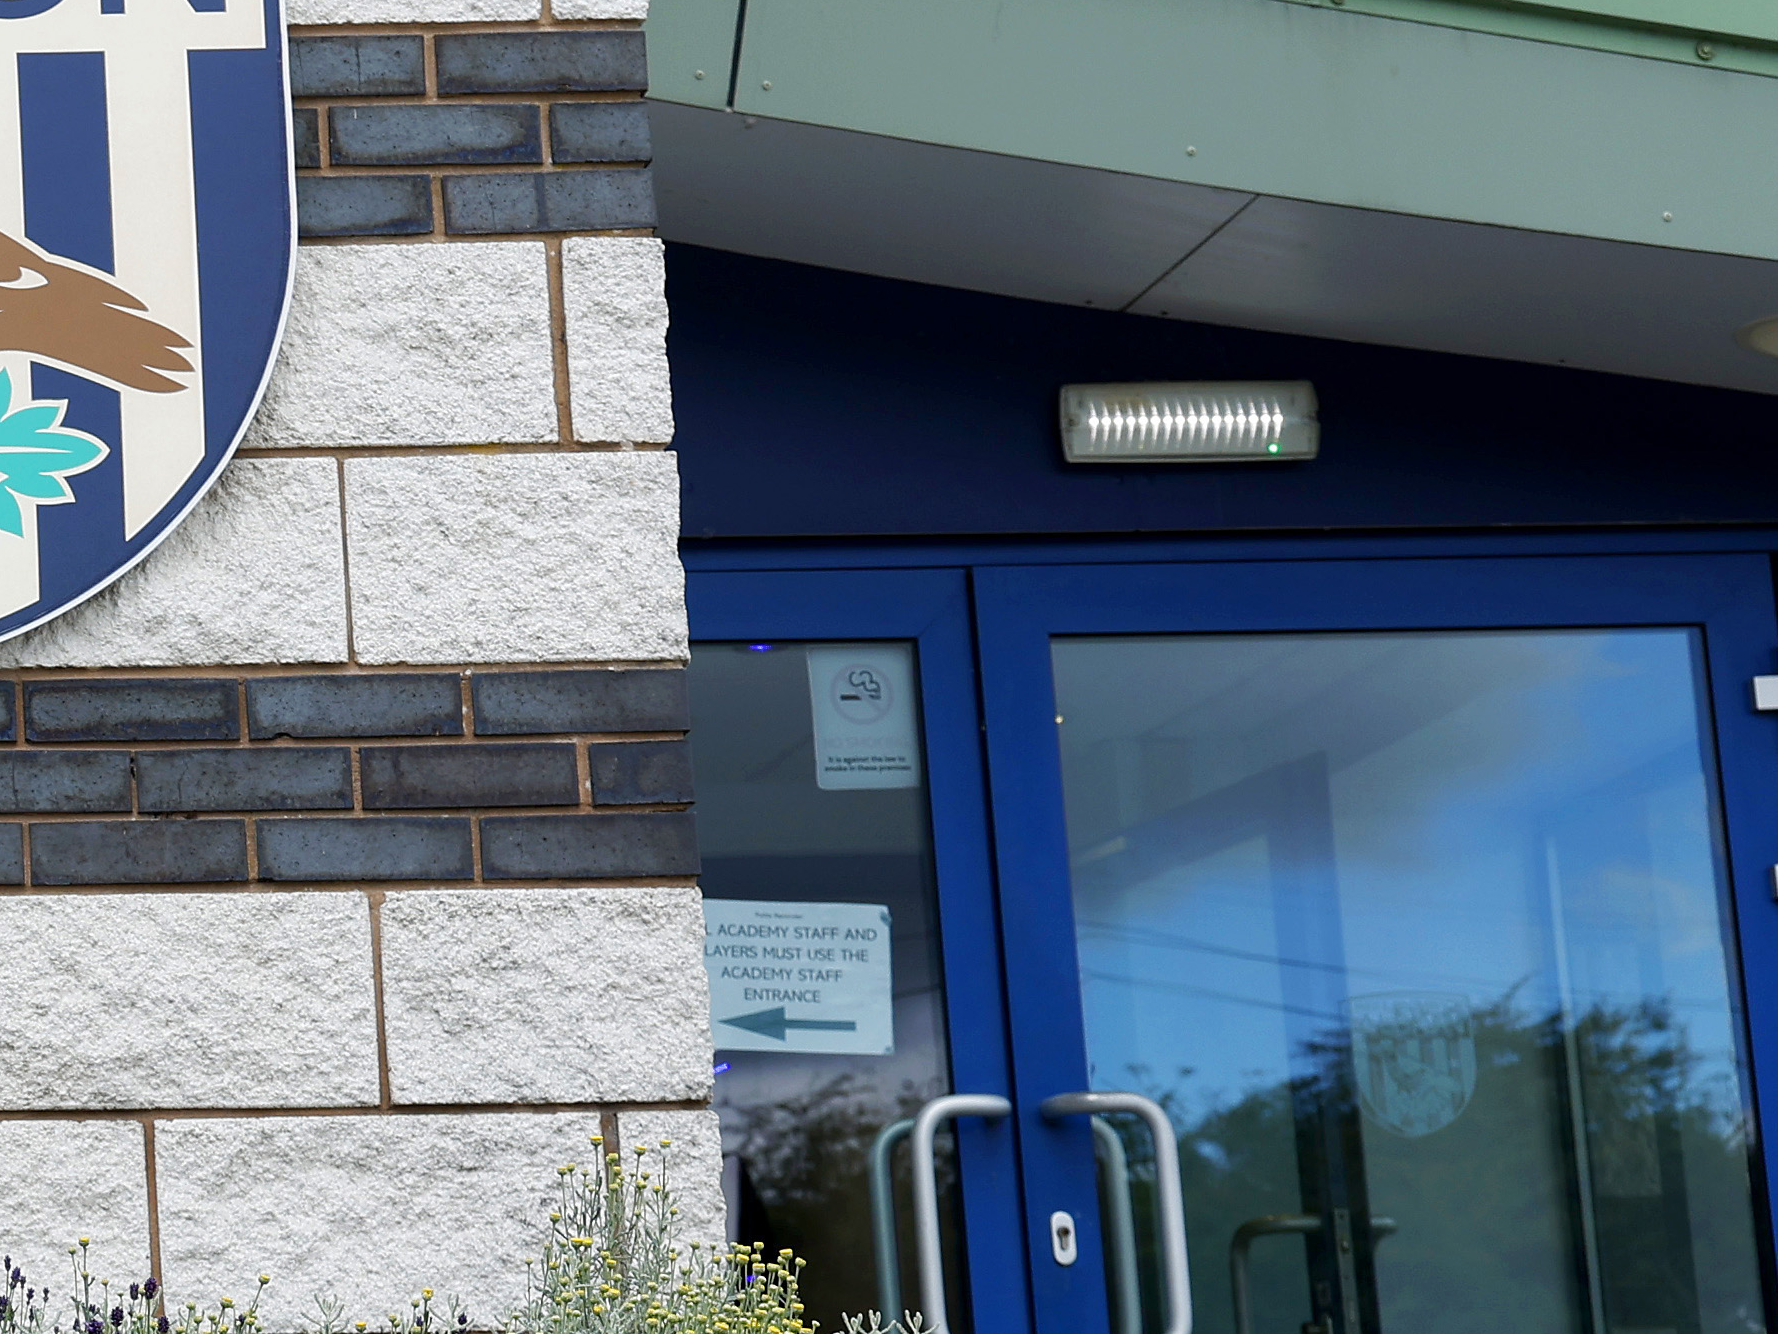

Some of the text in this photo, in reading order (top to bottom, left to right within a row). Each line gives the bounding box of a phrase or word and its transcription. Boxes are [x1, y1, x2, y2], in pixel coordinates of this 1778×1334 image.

[718, 924, 789, 938] ACADEMY
[794, 926, 840, 941] STAFF
[845, 928, 878, 942] AND
[704, 945, 869, 963] LAYERS MUST USE THE
[721, 966, 844, 983] ACADEMY STAFF
[744, 987, 822, 1004] ENTRANCE
